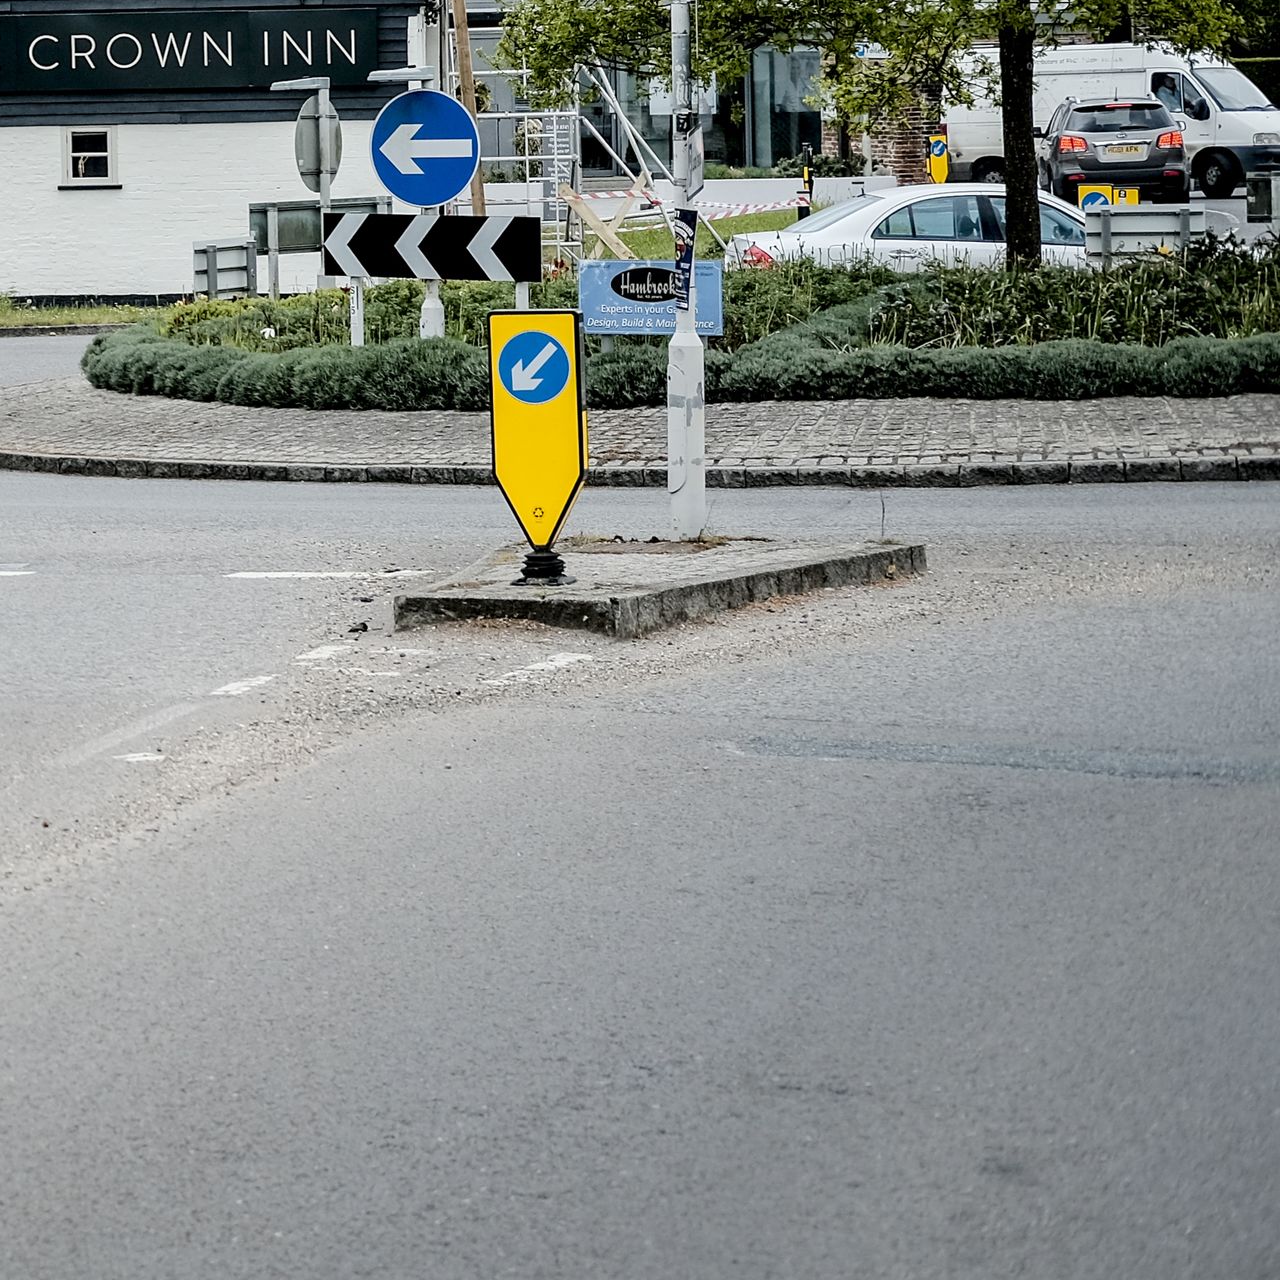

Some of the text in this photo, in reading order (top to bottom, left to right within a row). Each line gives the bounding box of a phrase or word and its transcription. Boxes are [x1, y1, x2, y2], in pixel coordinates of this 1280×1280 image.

[28, 31, 233, 70] CROWN
[264, 29, 356, 66] INN
[601, 305, 633, 314] Experts
[634, 304, 643, 313] in
[645, 305, 664, 314] your
[587, 317, 619, 329] Design,
[622, 318, 644, 328] Build
[645, 318, 653, 328] &
